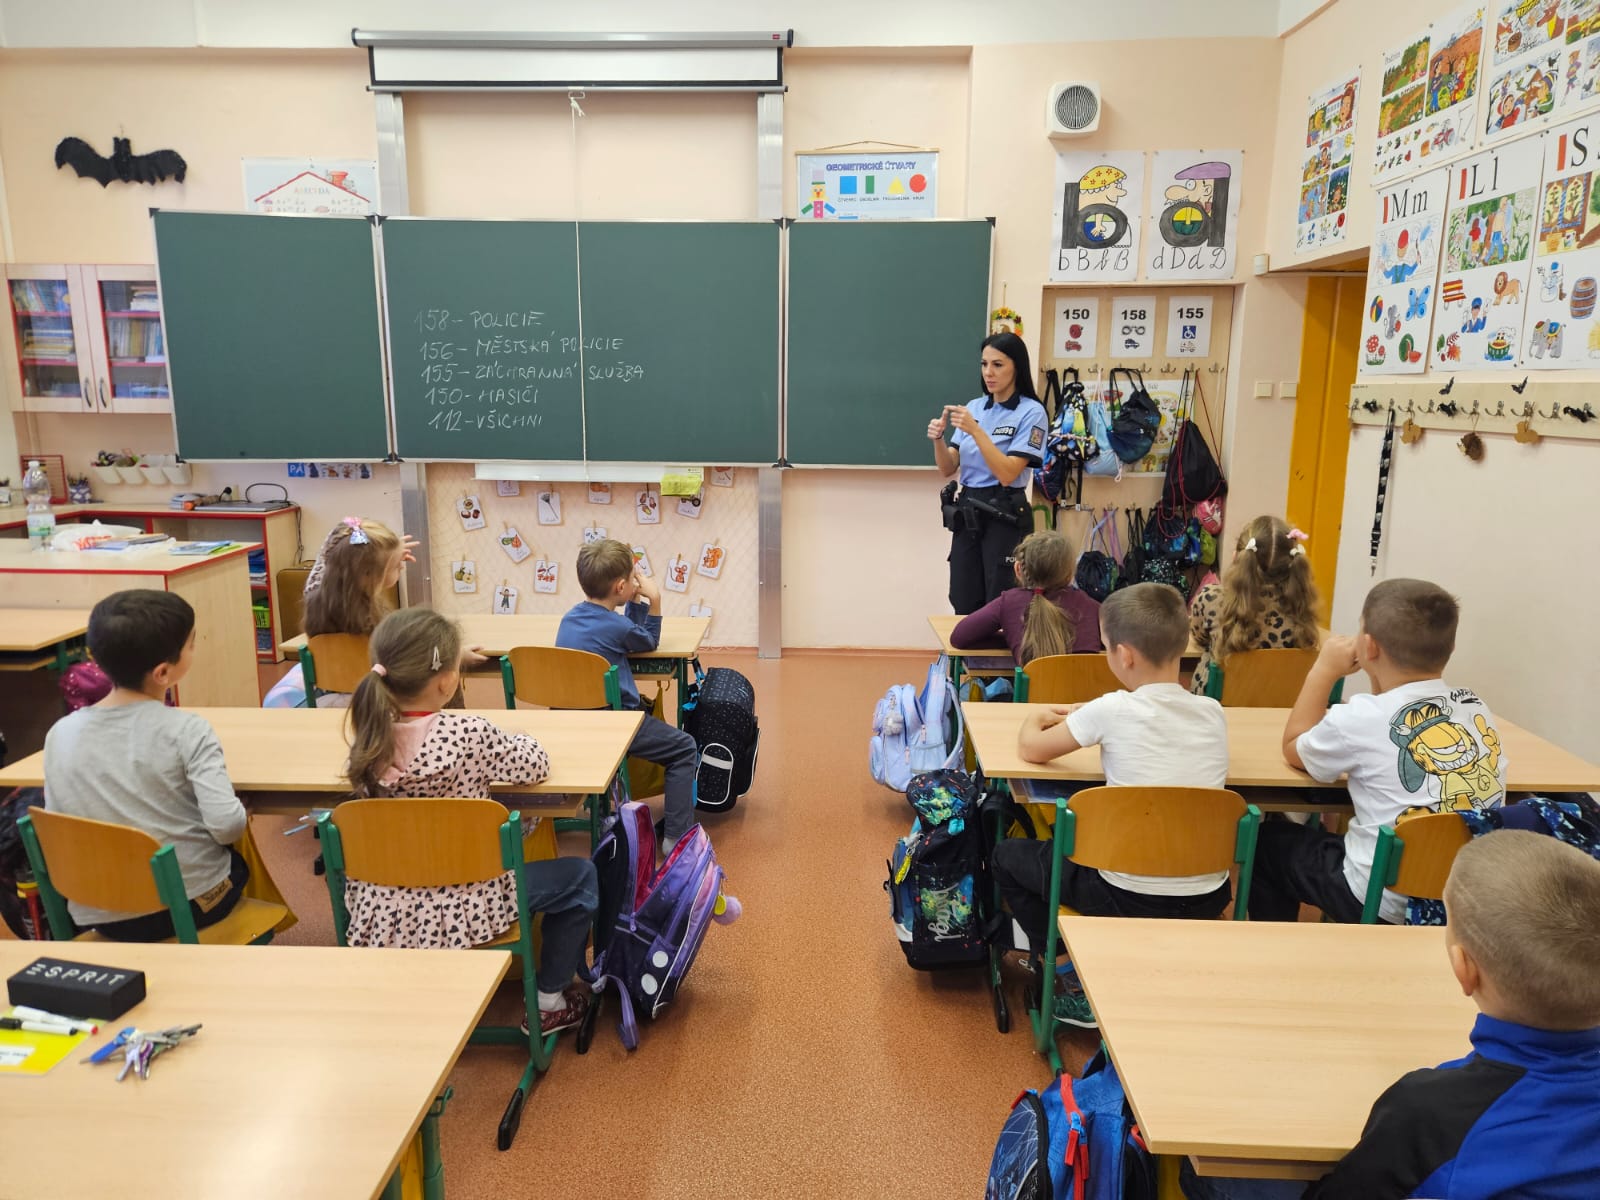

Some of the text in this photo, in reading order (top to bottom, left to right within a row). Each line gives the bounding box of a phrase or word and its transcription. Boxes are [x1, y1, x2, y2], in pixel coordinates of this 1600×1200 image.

[470, 310, 545, 329] POLICIE
[1063, 308, 1090, 320] 150
[1121, 309, 1147, 321] 158
[1177, 307, 1204, 319] 155
[476, 331, 556, 357] MĚSTSKÁ
[588, 361, 644, 382] SLUŽBA
[26, 963, 126, 985] ESPRIT
